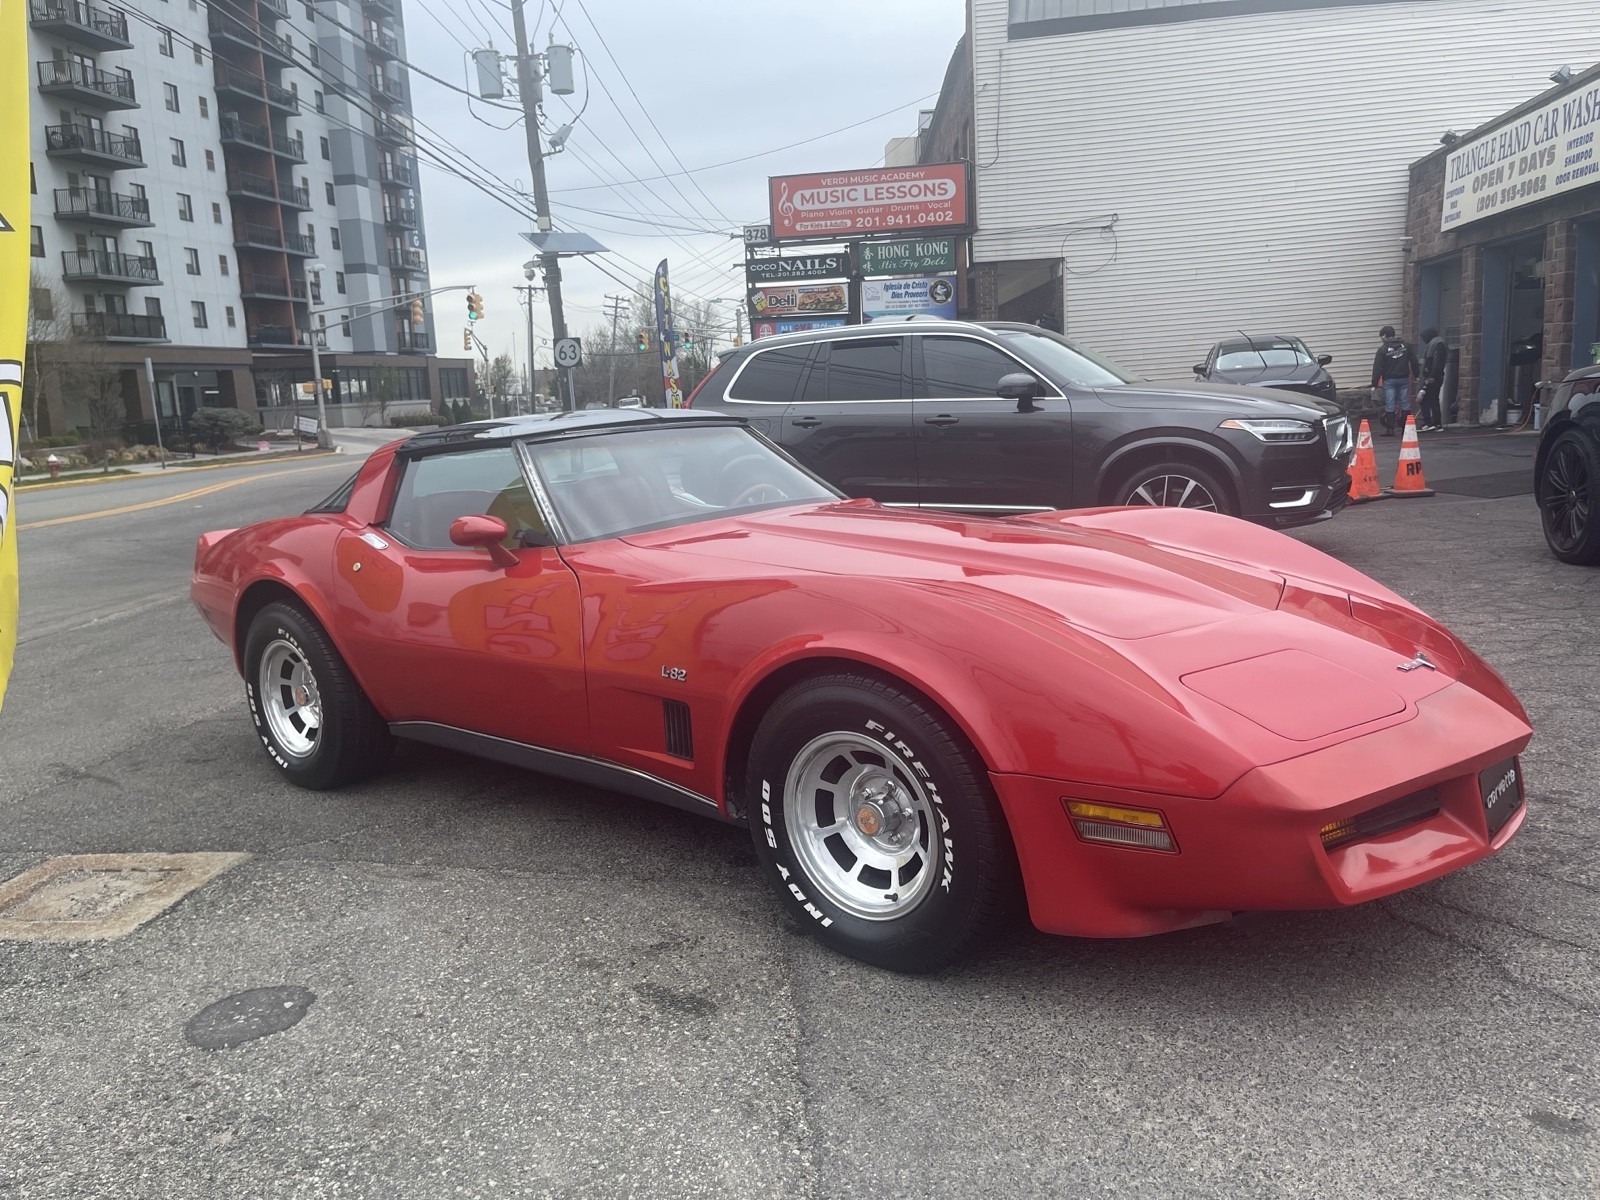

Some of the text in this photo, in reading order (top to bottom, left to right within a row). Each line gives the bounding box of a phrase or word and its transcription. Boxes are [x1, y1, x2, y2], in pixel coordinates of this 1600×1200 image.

[1450, 88, 1600, 183] TRIANGLE HAND CAR WASH
[1566, 132, 1594, 151] INTERIOR
[1564, 148, 1593, 168] SHAMPOO
[821, 171, 925, 186] VERDI MUSIC ACADEMY
[1472, 144, 1556, 194] OPEN 7 DAYS
[1555, 161, 1599, 186] ODOR REMOVAL
[800, 182, 948, 206] MUSIC LESSONS
[1476, 190, 1498, 213] (201)
[801, 201, 951, 218] Piano Violin Guitar Drums Vocal
[856, 211, 953, 228] 201.941.0402
[746, 228, 767, 241] 378
[877, 241, 949, 260] HONG KONG
[778, 257, 837, 272] NAILS
[879, 257, 947, 270] Stir Fry Deli
[883, 282, 902, 292] Iglesia
[911, 281, 928, 289] Cristo
[891, 291, 903, 299] Dios
[768, 293, 796, 308] Deli
[559, 344, 577, 360] 63
[661, 665, 687, 681] L-82
[262, 735, 289, 769] INDY
[1486, 769, 1516, 809] corvette
[865, 718, 953, 893] FIREHAWK
[761, 779, 833, 928] INDY 500
